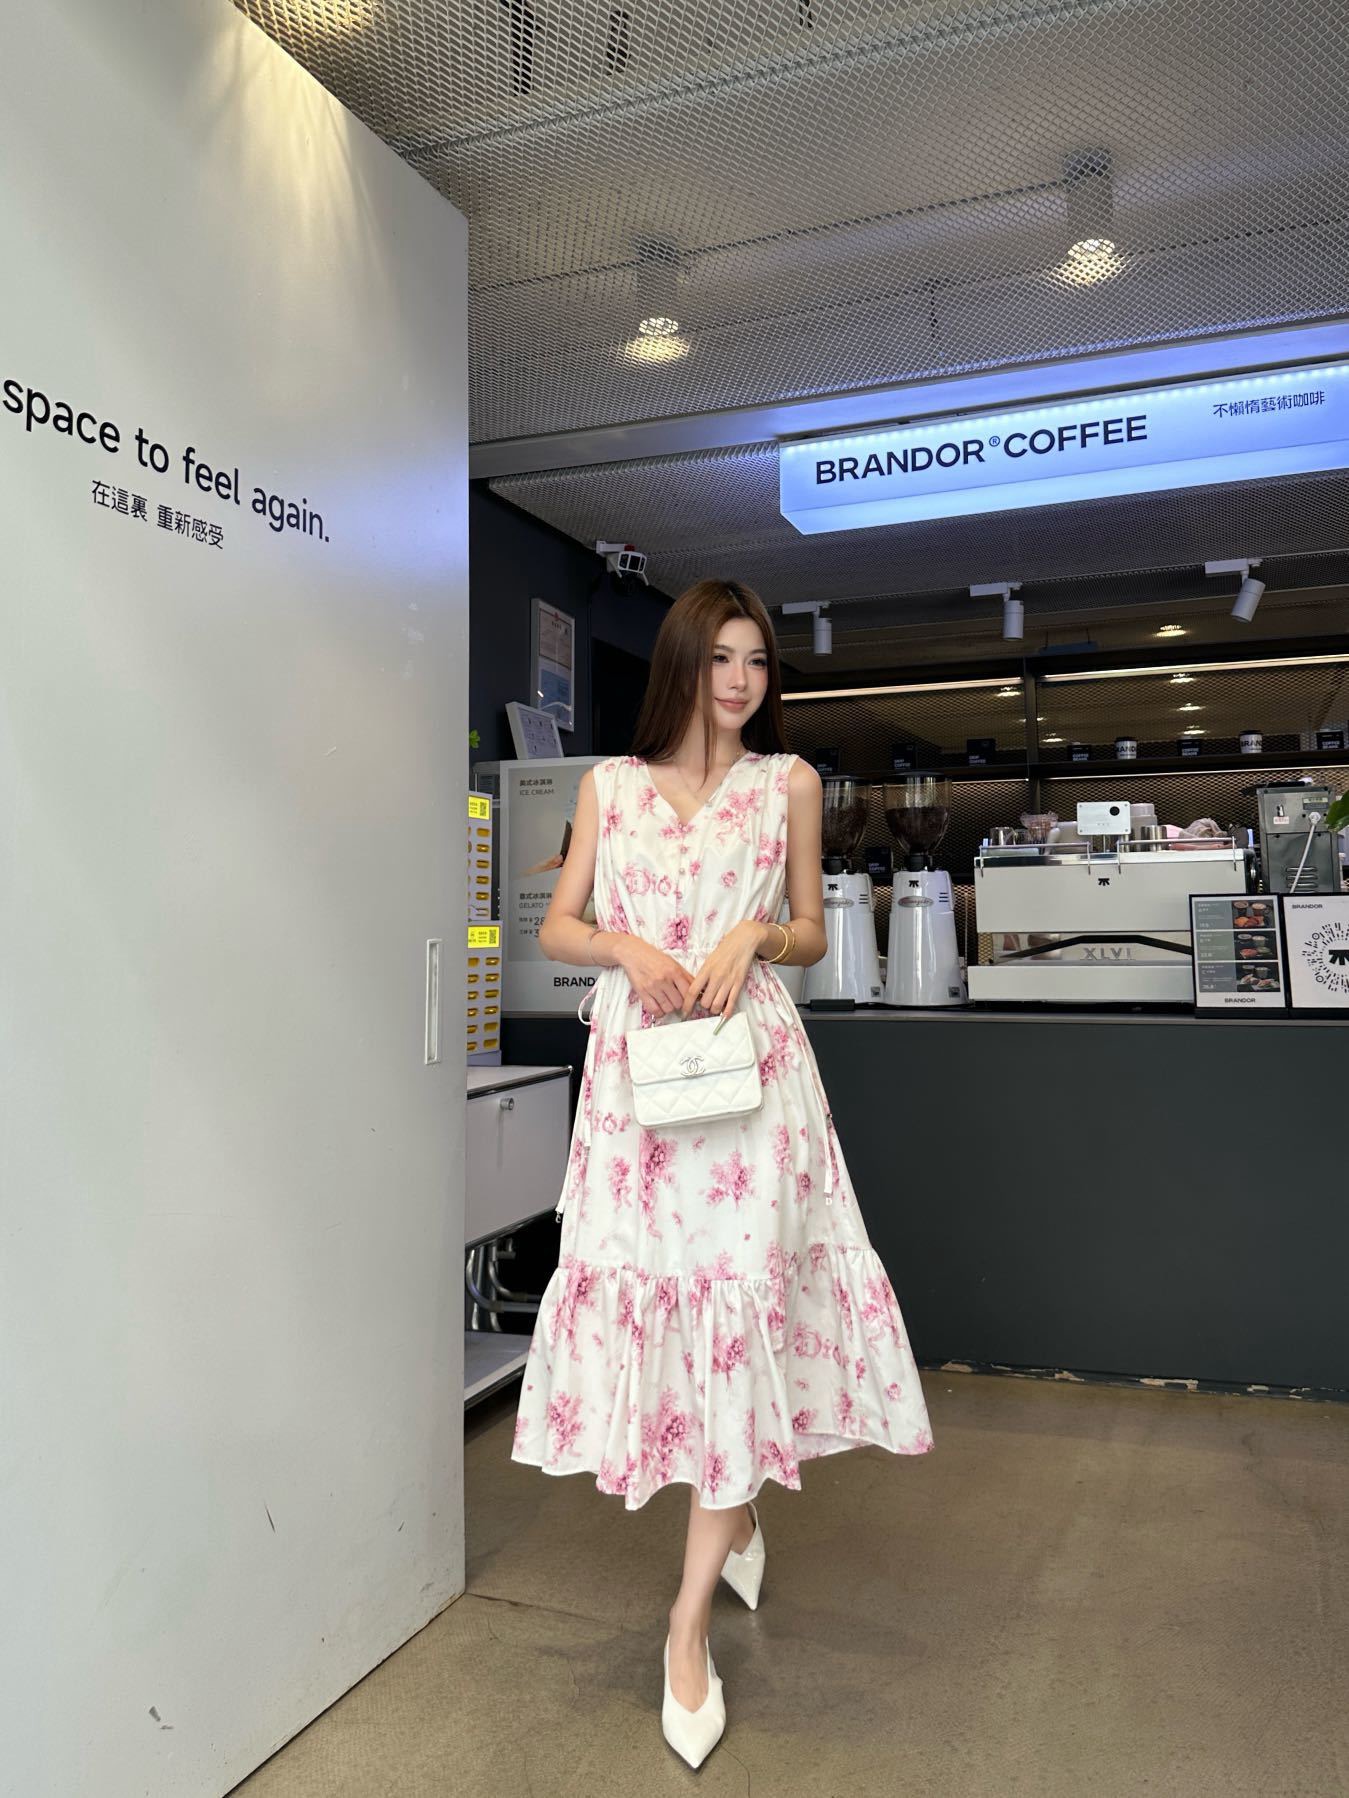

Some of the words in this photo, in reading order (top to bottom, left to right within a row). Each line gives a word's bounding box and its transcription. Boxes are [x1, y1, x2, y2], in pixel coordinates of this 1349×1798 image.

[1003, 415, 1148, 457] COFFEE
[3, 379, 120, 453] space
[135, 428, 169, 473] to
[182, 446, 241, 505] feel
[251, 487, 330, 542] again.
[1082, 947, 1134, 960] XLVI
[553, 977, 599, 987] BRAND
